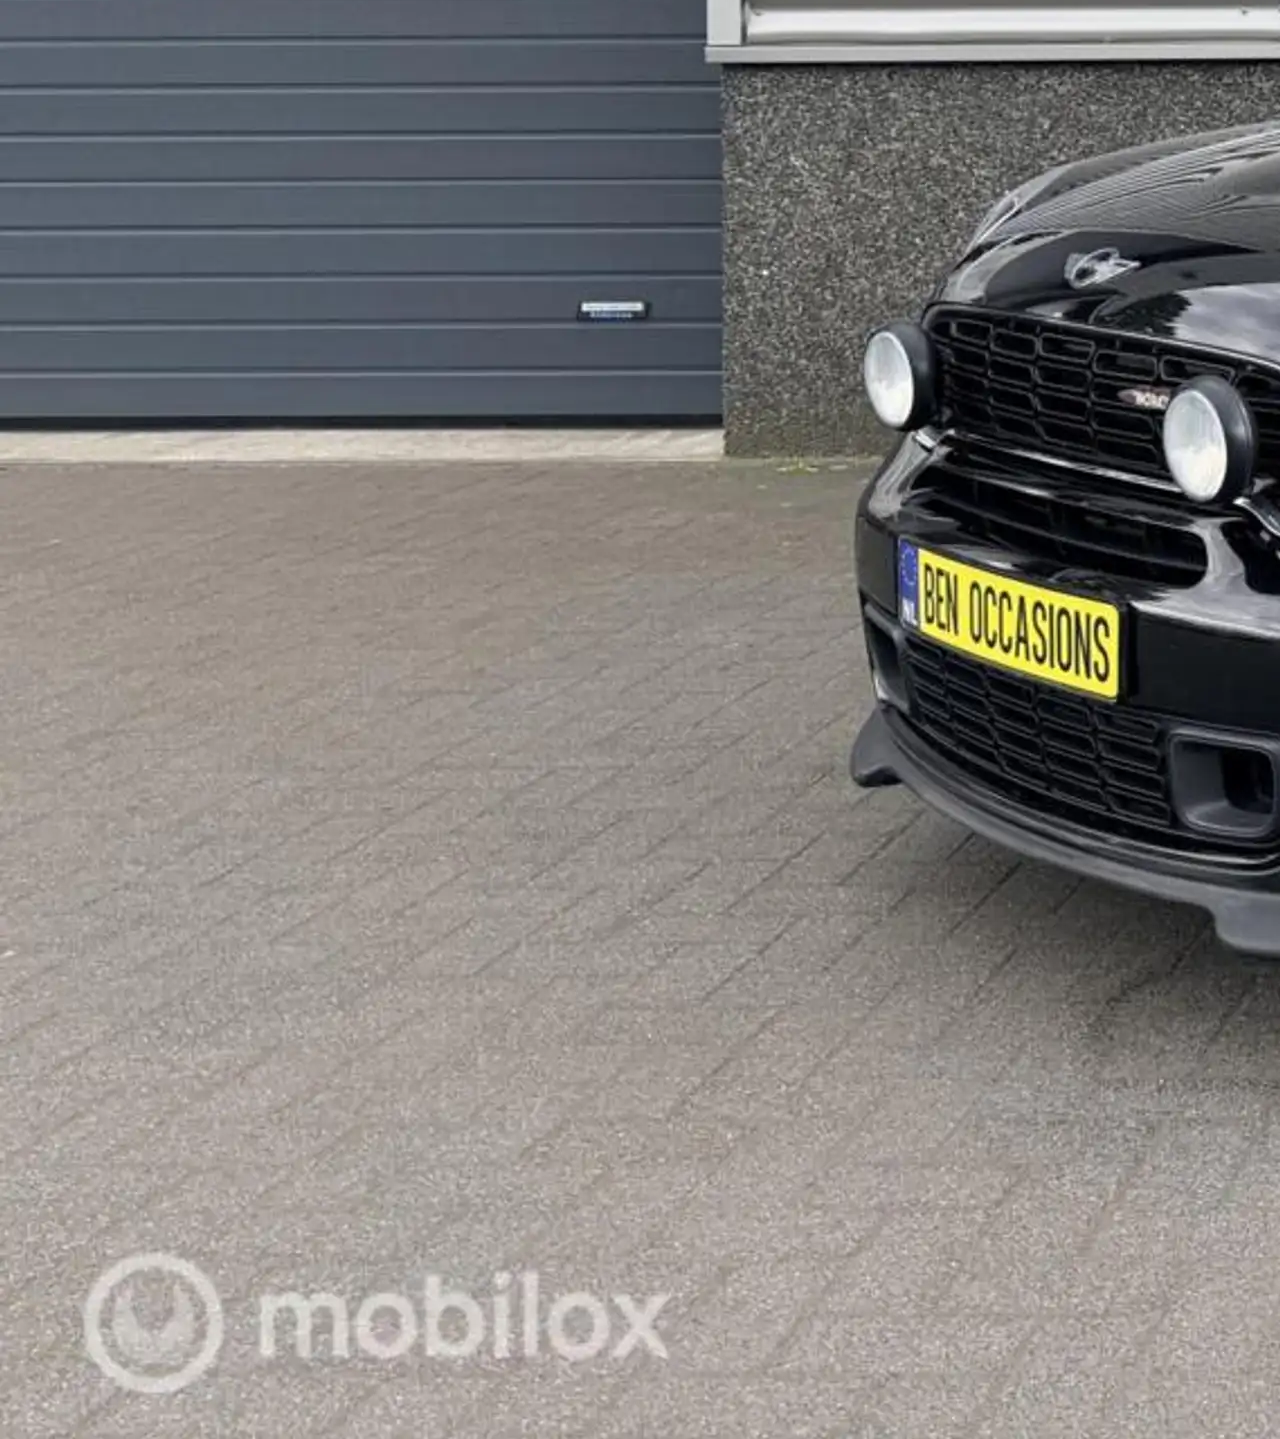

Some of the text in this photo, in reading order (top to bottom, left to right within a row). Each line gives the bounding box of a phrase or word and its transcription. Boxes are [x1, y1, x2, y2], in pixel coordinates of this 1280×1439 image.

[901, 597, 918, 627] NL
[923, 562, 1111, 683] BEN OCCASIONS
